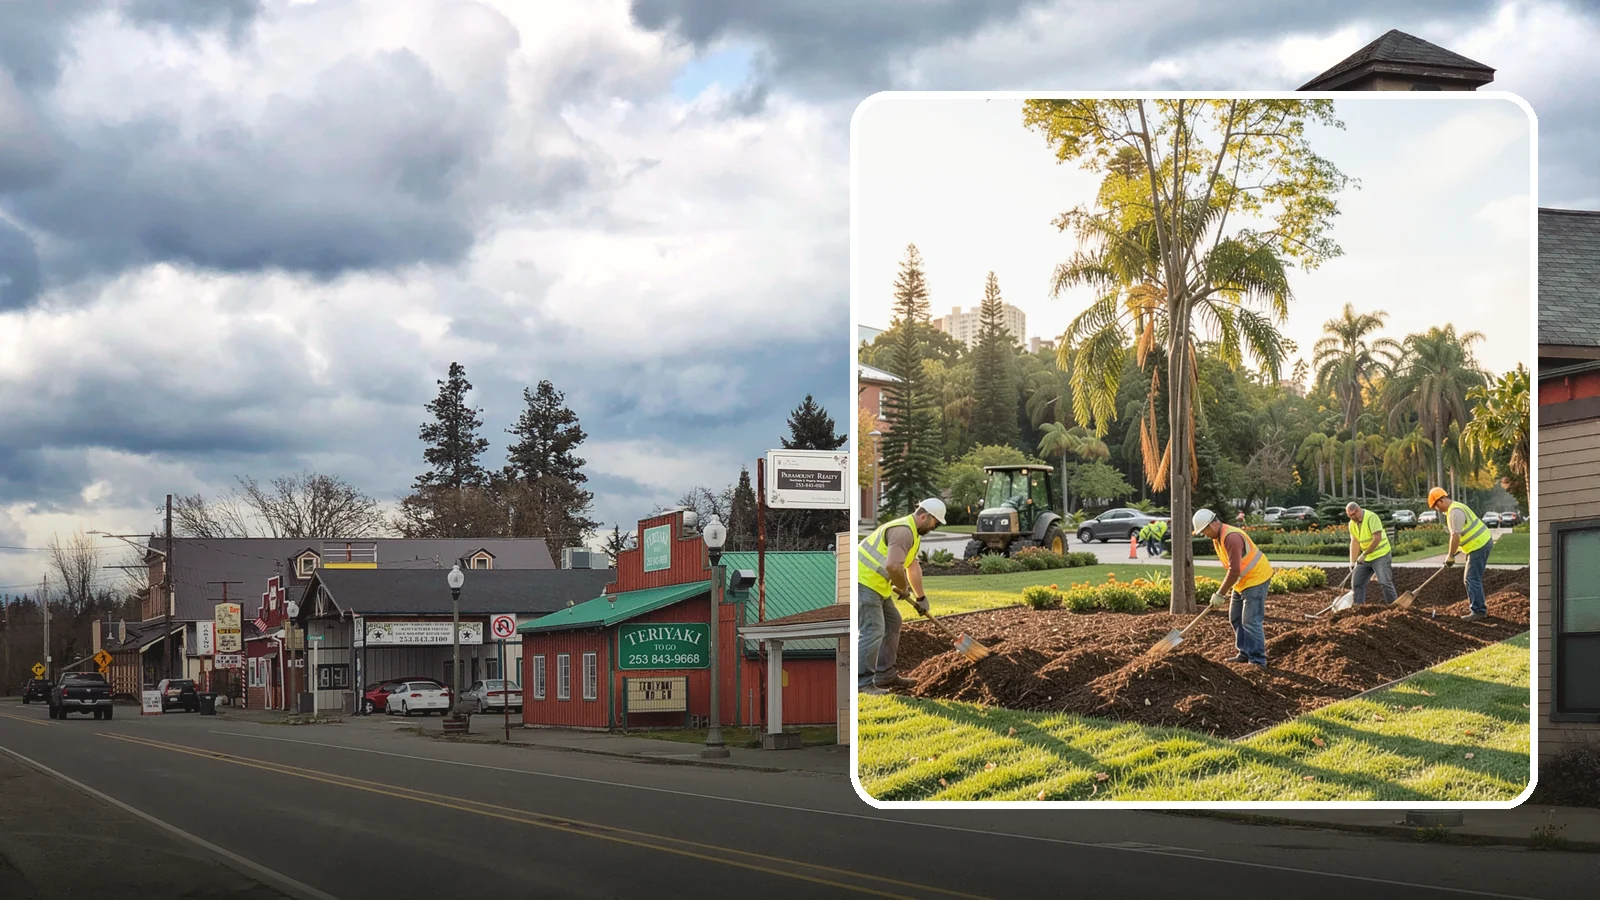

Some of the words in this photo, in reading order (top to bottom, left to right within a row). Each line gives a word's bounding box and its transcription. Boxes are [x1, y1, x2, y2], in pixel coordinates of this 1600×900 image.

[781, 471, 814, 479] PARAMOUNT
[817, 472, 839, 480] REALTY
[625, 627, 702, 646] TERIYAKI
[654, 643, 664, 651] TO
[665, 643, 676, 651] GO
[628, 654, 649, 664] 253
[651, 653, 700, 664] 843-9668
